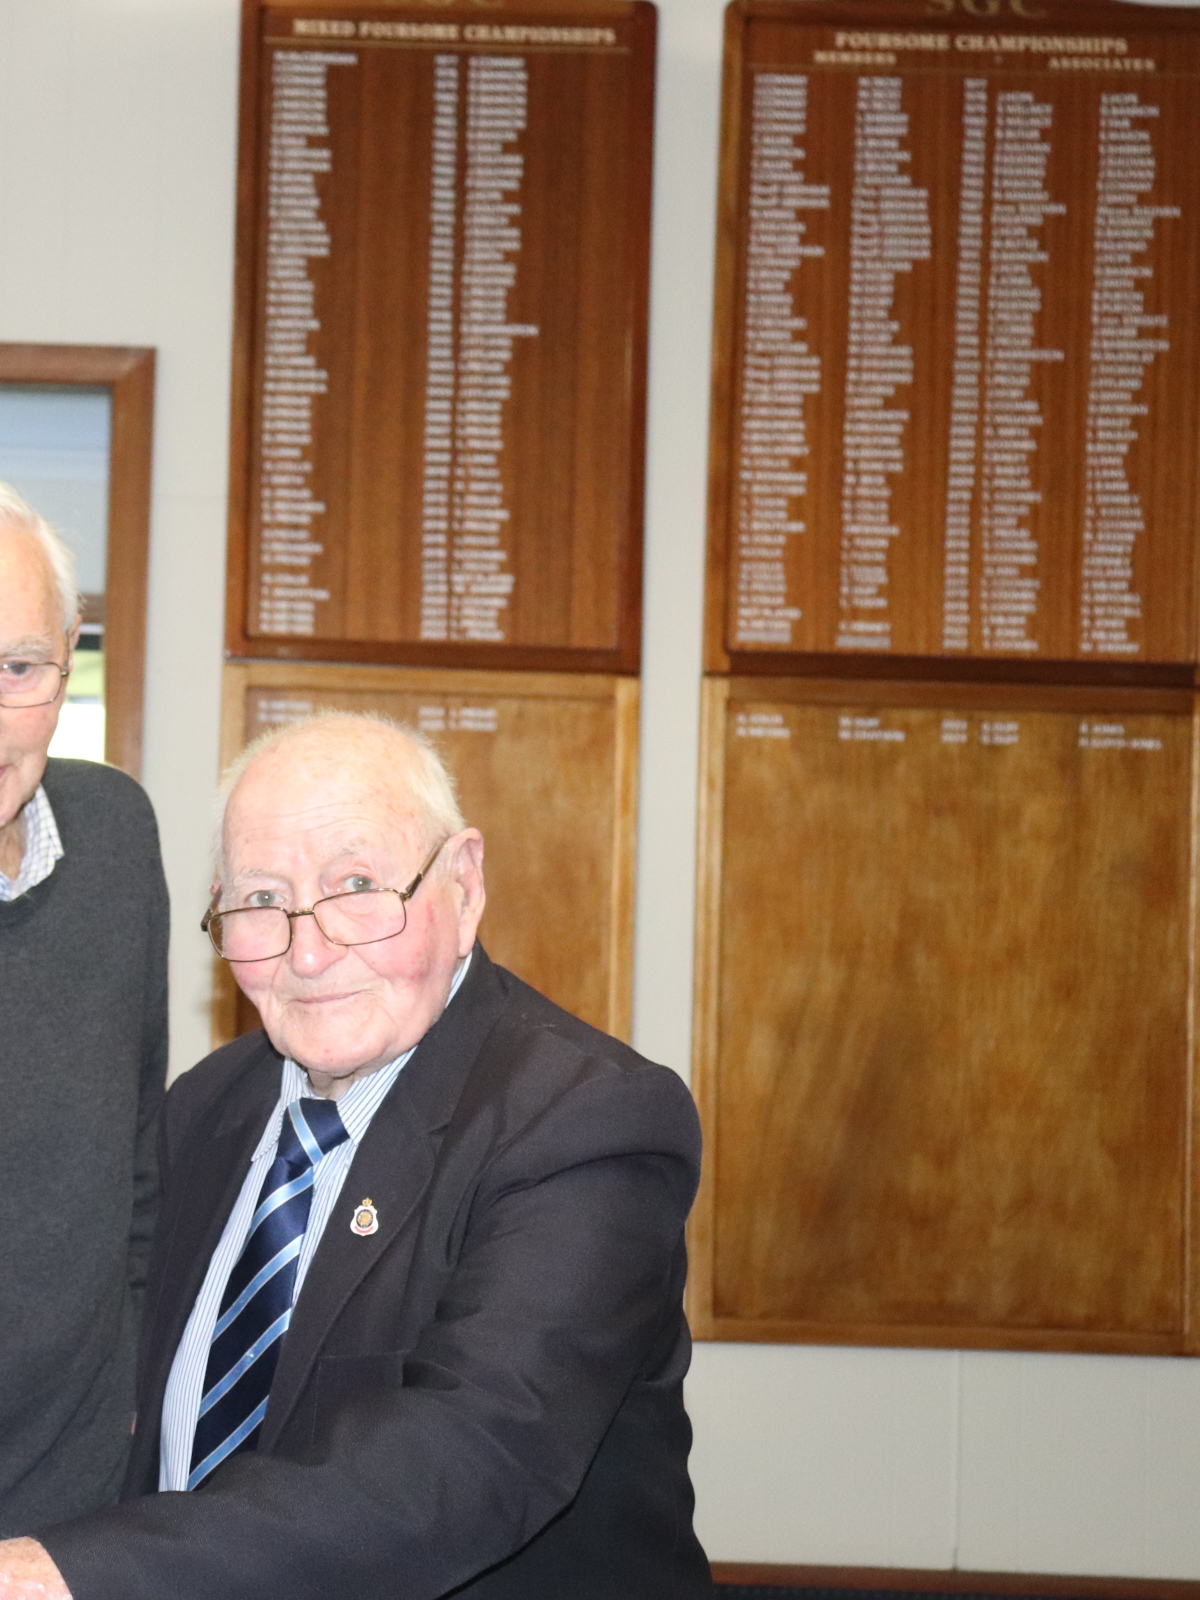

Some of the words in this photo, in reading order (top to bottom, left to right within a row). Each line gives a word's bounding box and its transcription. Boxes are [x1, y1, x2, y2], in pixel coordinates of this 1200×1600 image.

[293, 19, 356, 37] MIXED
[359, 22, 459, 40] FOURSOME
[463, 25, 616, 44] CHAMPIONSHIPS
[835, 32, 949, 51] FOURSOME
[955, 34, 1128, 54] CHAMPIONSHIPS
[814, 51, 896, 65] MEMBERS
[1049, 56, 1155, 72] ASSOCIATES
